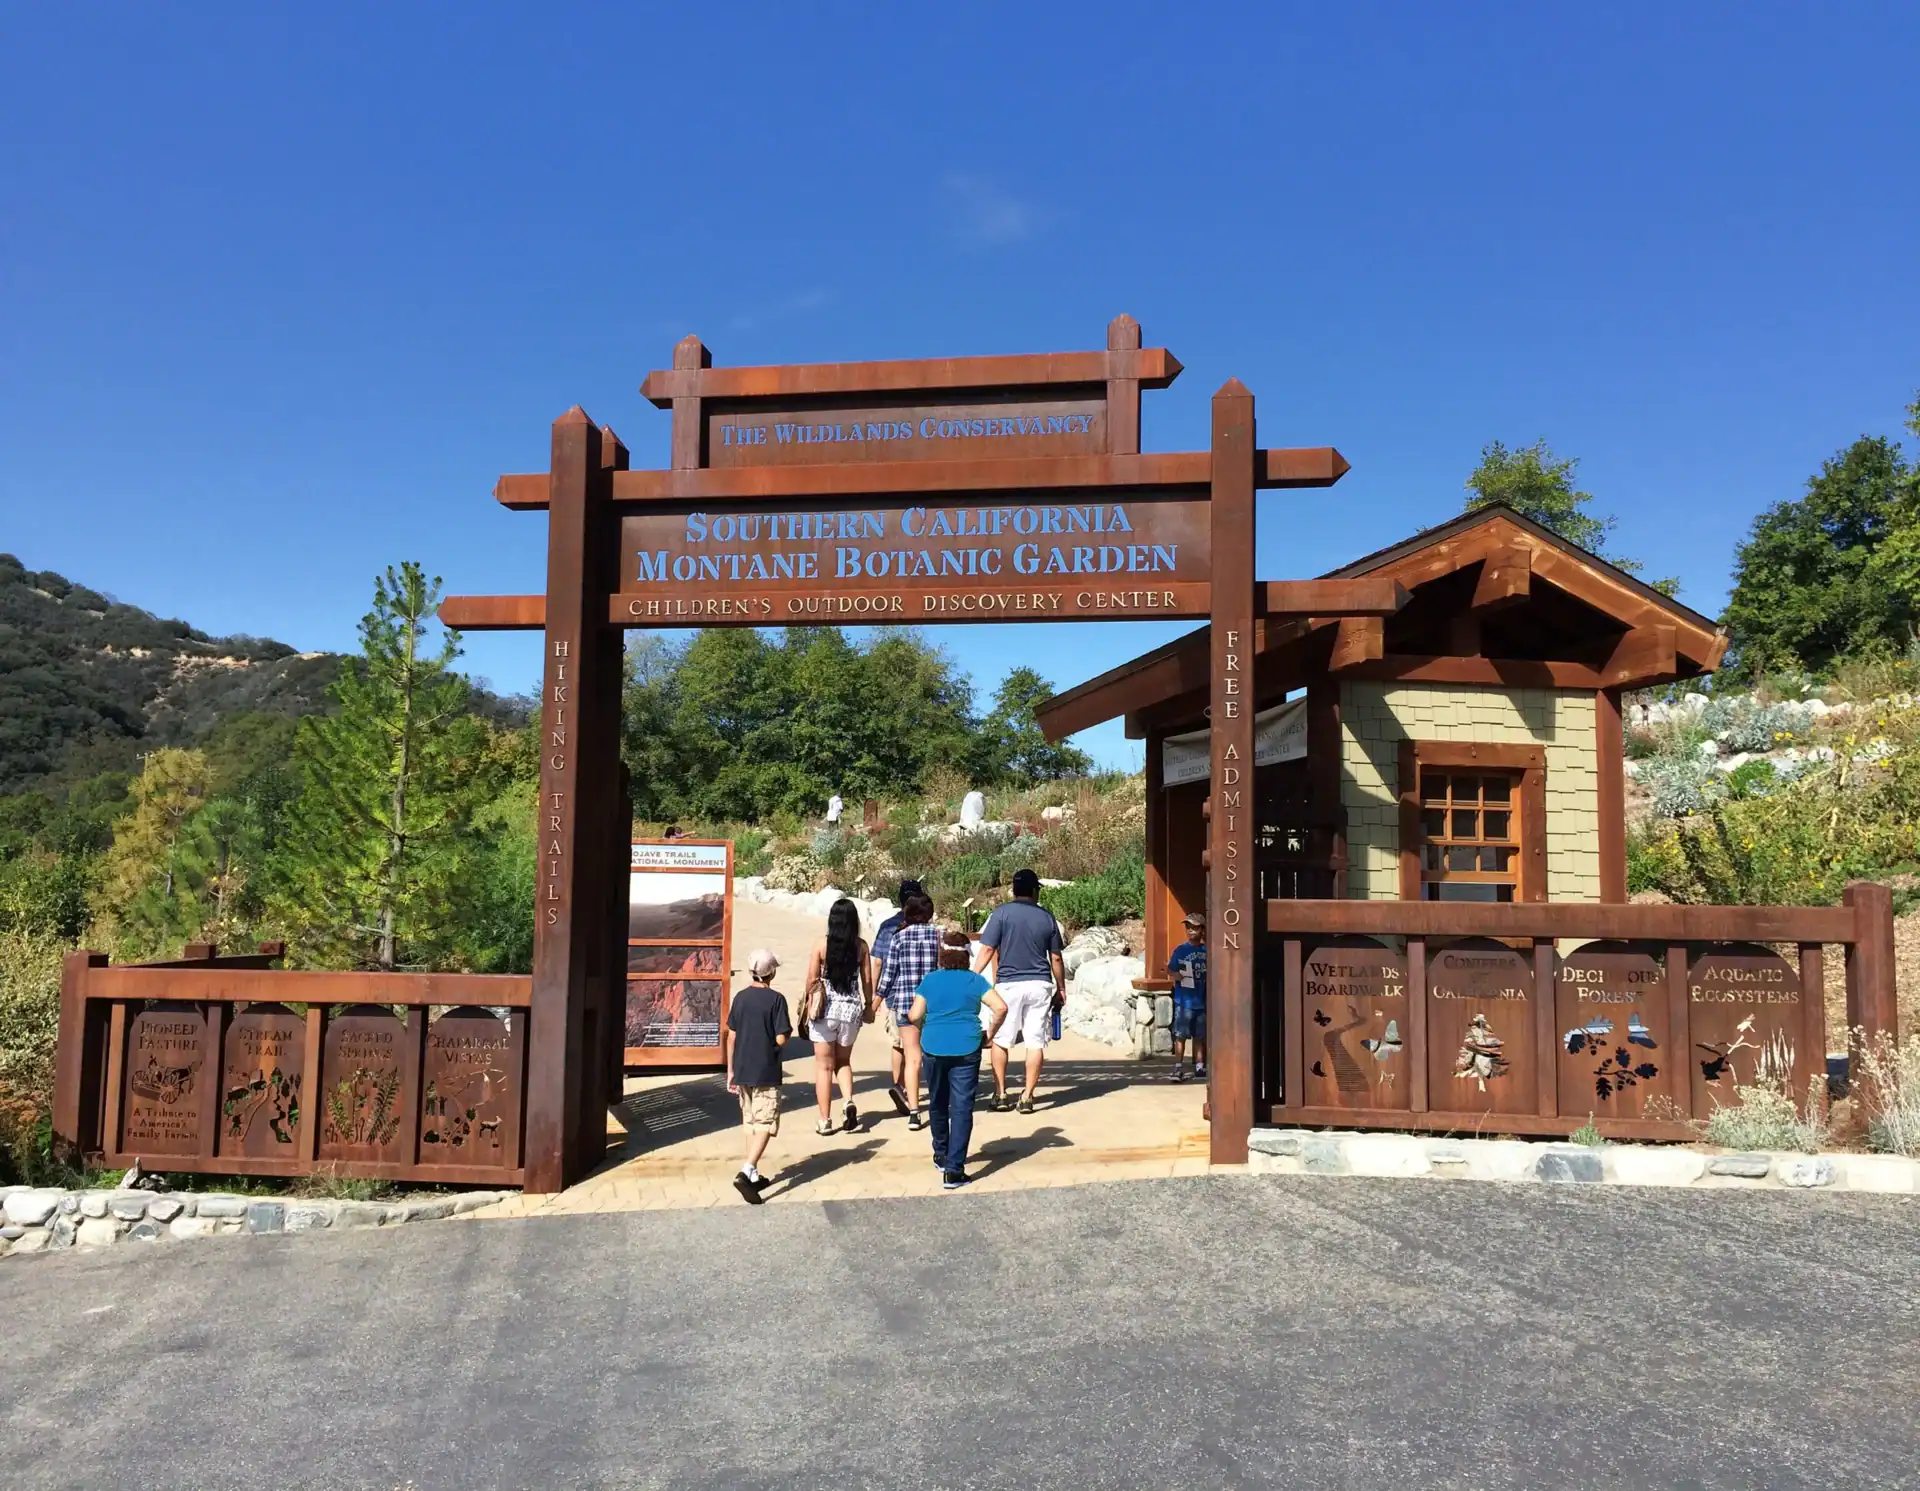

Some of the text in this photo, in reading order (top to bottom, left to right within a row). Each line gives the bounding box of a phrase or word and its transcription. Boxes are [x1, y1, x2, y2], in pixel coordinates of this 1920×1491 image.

[720, 415, 1093, 446] THE WILDLANDS CONSERVANCY
[686, 505, 1133, 543] SOUTHERN CALIFORNIA
[637, 543, 1178, 582] MONTANE BOTANIC GARDEN
[628, 591, 1178, 617] CHILDREN'S OUTDOOR DISCOVERY CENTER
[547, 641, 569, 926] HIKING TRAILS
[1222, 630, 1242, 951] FREE ADMISSION
[673, 859, 725, 867] MONUMENT
[1562, 966, 1660, 985] DECIOUS
[1704, 965, 1784, 983] AQUATIC
[1305, 980, 1404, 997] BOARDWLK
[444, 1050, 493, 1064] VISTAS
[133, 1107, 141, 1117] A
